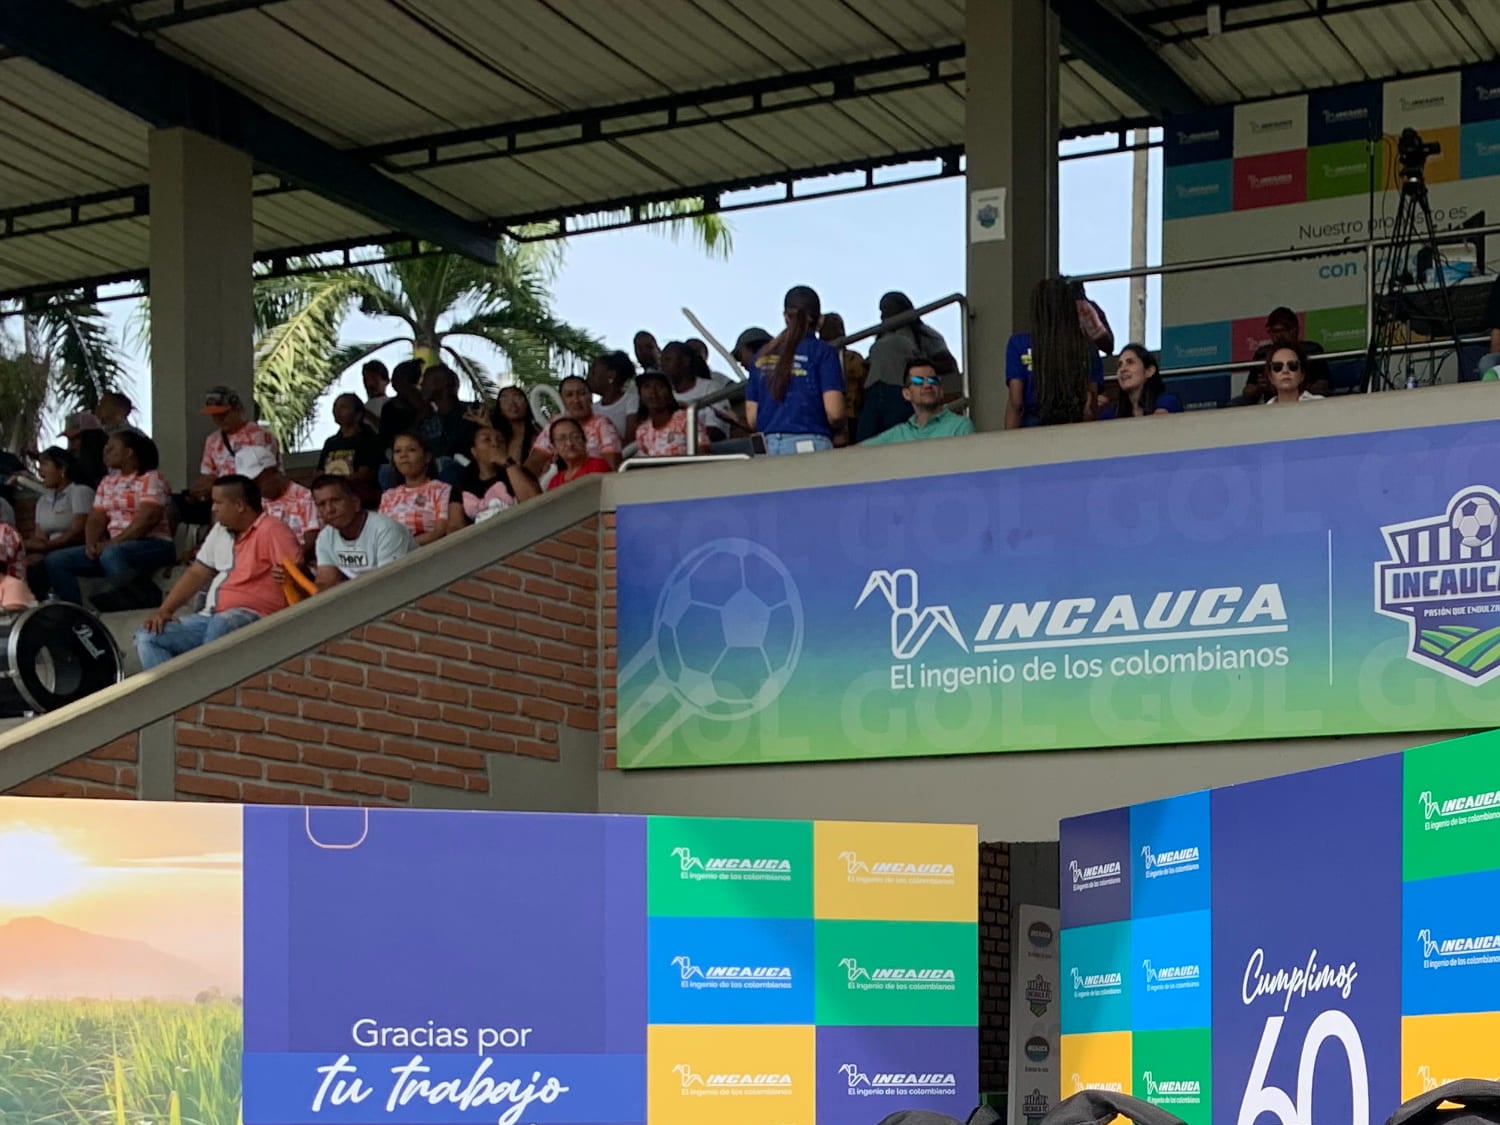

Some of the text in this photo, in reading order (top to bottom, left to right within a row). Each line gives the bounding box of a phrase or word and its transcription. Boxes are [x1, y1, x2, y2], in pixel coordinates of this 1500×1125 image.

[1299, 219, 1363, 241] Nuestro
[1449, 206, 1468, 220] es
[1318, 261, 1358, 280] con
[975, 583, 1288, 642] INCAUCA
[1452, 606, 1466, 616] QUE
[890, 645, 1289, 693] El ingenio de los colombianos
[1156, 846, 1199, 864] INCAUCA
[705, 858, 791, 870] INCAUCA
[872, 862, 954, 874] INCAUCA
[1083, 861, 1121, 878] INCAUCA
[705, 967, 792, 978] INCAUCA
[872, 968, 955, 980] INCAUCA
[1084, 972, 1122, 986] INCAUCA
[1158, 965, 1199, 979] INCAUCA
[1242, 948, 1358, 1013] Cumplimos
[352, 1018, 533, 1057] Gracias por
[312, 1054, 373, 1112] tu
[706, 1073, 792, 1085] INCAUCA
[872, 1073, 956, 1085] INCAUCA
[1158, 1080, 1200, 1092] INCAUCA
[856, 1088, 884, 1097] ingenio
[885, 1088, 895, 1096] de
[896, 1088, 907, 1096] los
